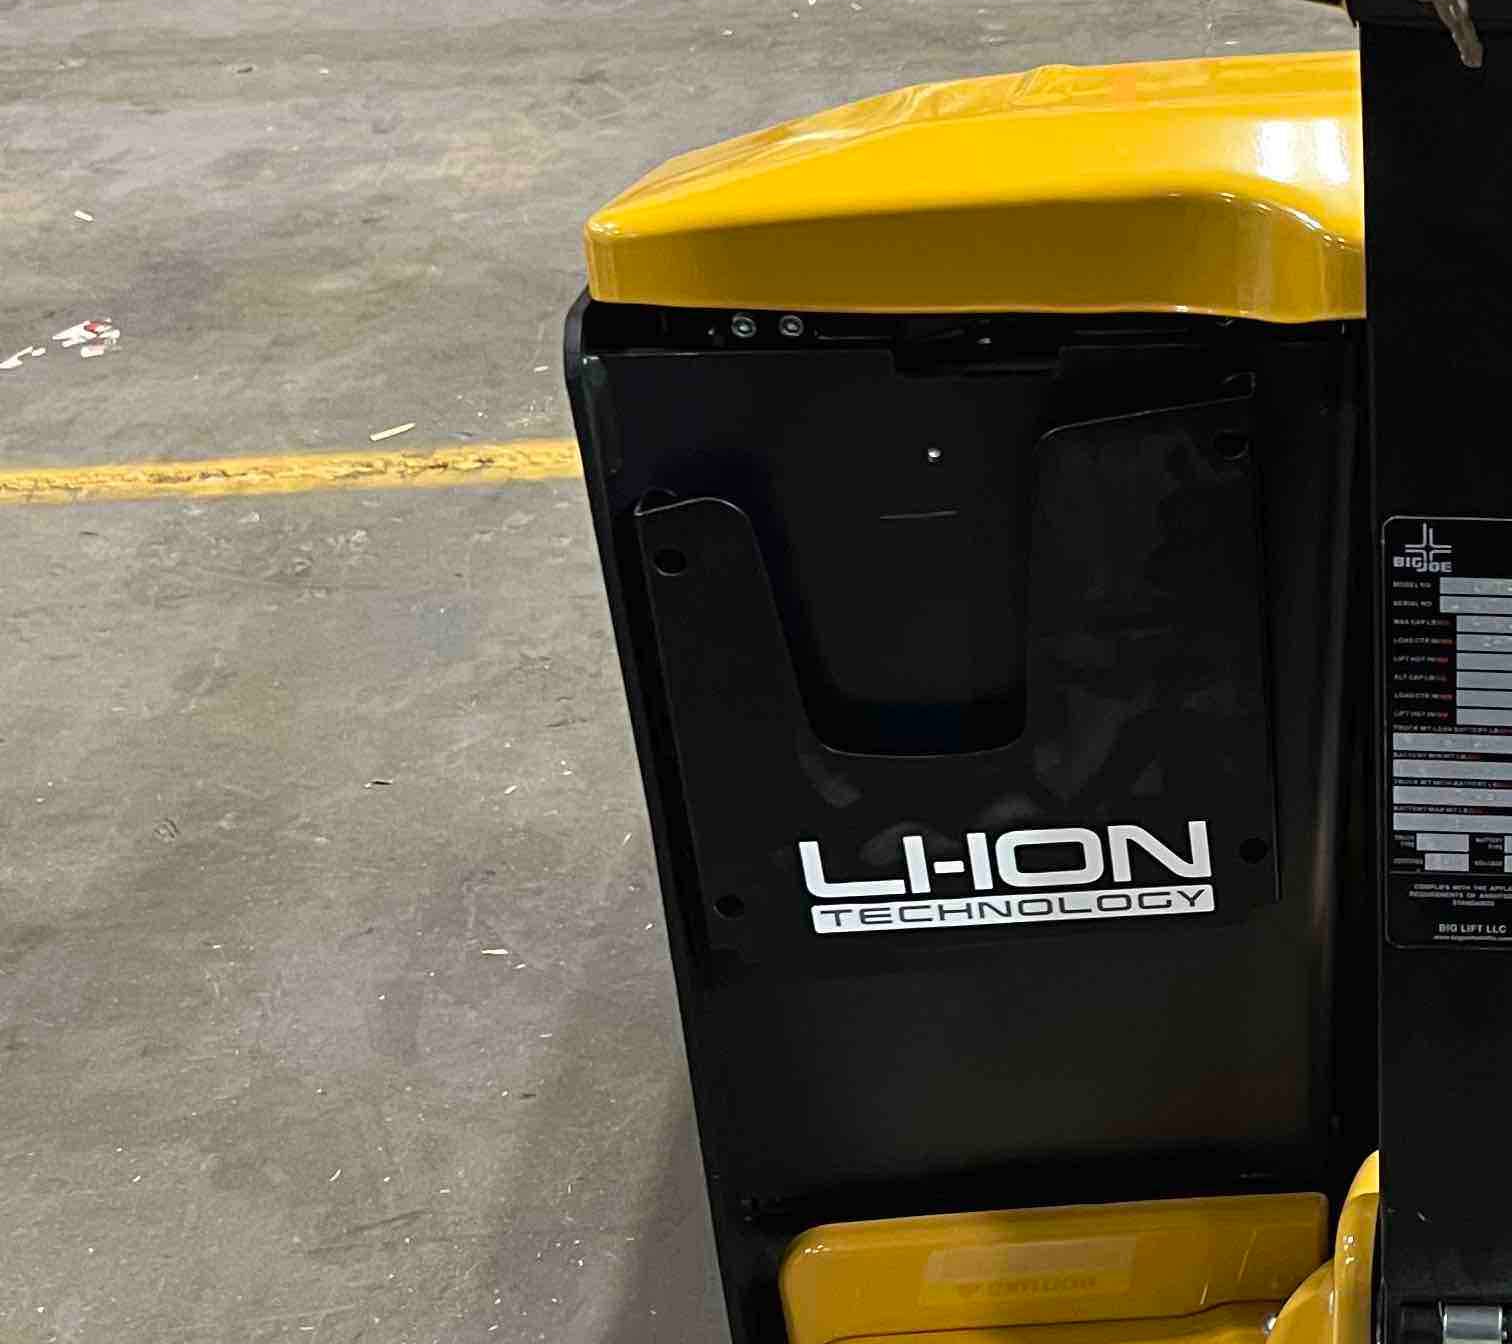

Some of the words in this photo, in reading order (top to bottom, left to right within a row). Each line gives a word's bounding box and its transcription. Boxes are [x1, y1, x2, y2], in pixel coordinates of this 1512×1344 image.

[798, 821, 1212, 898] LI-ION
[820, 888, 1207, 928] TECHNOLOGY
[1438, 923, 1458, 933] BIG
[1461, 924, 1482, 933] LIFT
[1486, 924, 1507, 934] LLC
